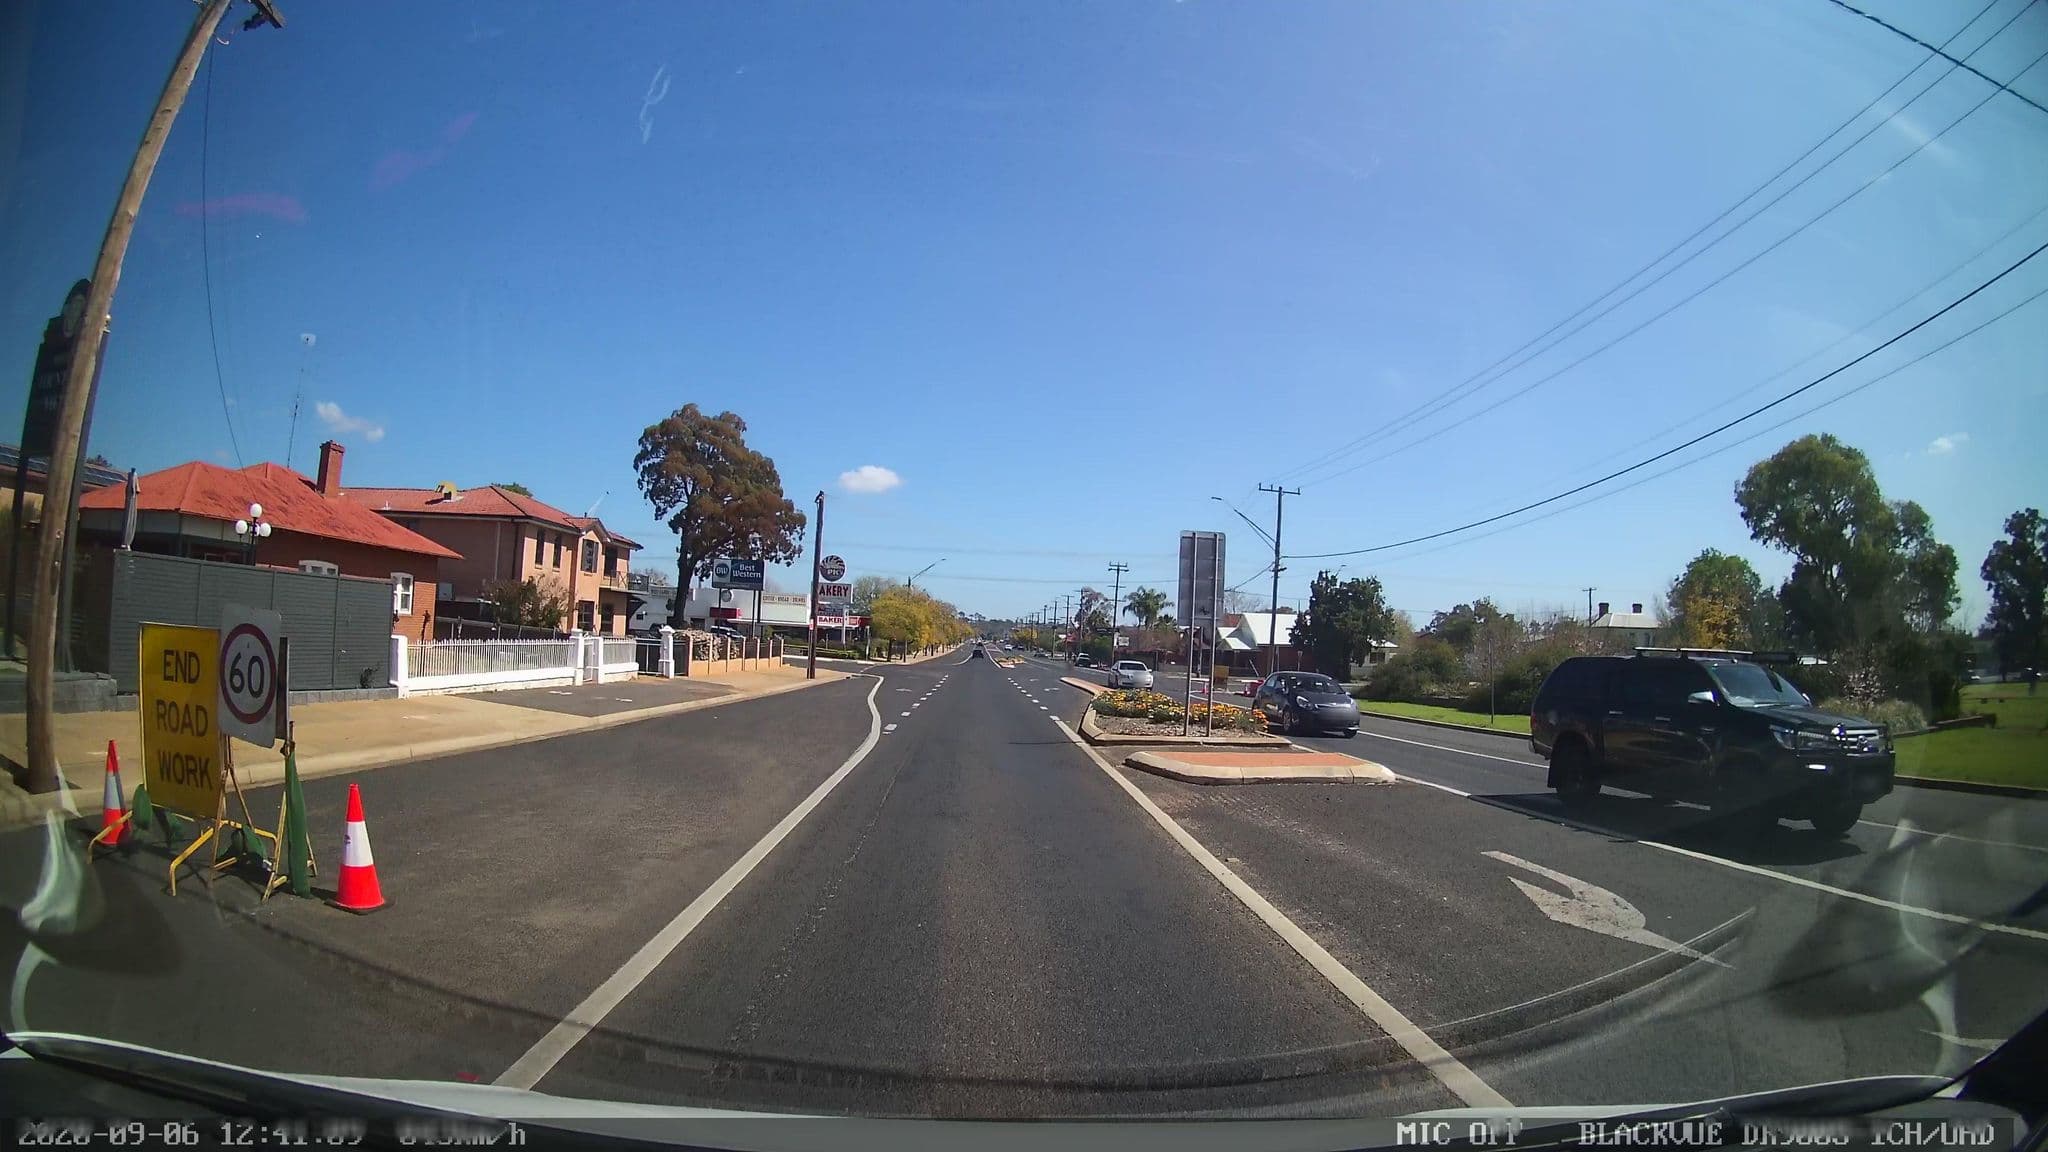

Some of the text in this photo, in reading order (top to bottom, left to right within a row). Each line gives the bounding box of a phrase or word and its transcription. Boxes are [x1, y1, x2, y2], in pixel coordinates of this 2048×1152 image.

[732, 570, 761, 578] Western
[818, 584, 849, 598] AKERY
[163, 650, 201, 684] END
[229, 652, 265, 699] 60
[156, 700, 209, 737] ROAD
[158, 751, 213, 790] WORK
